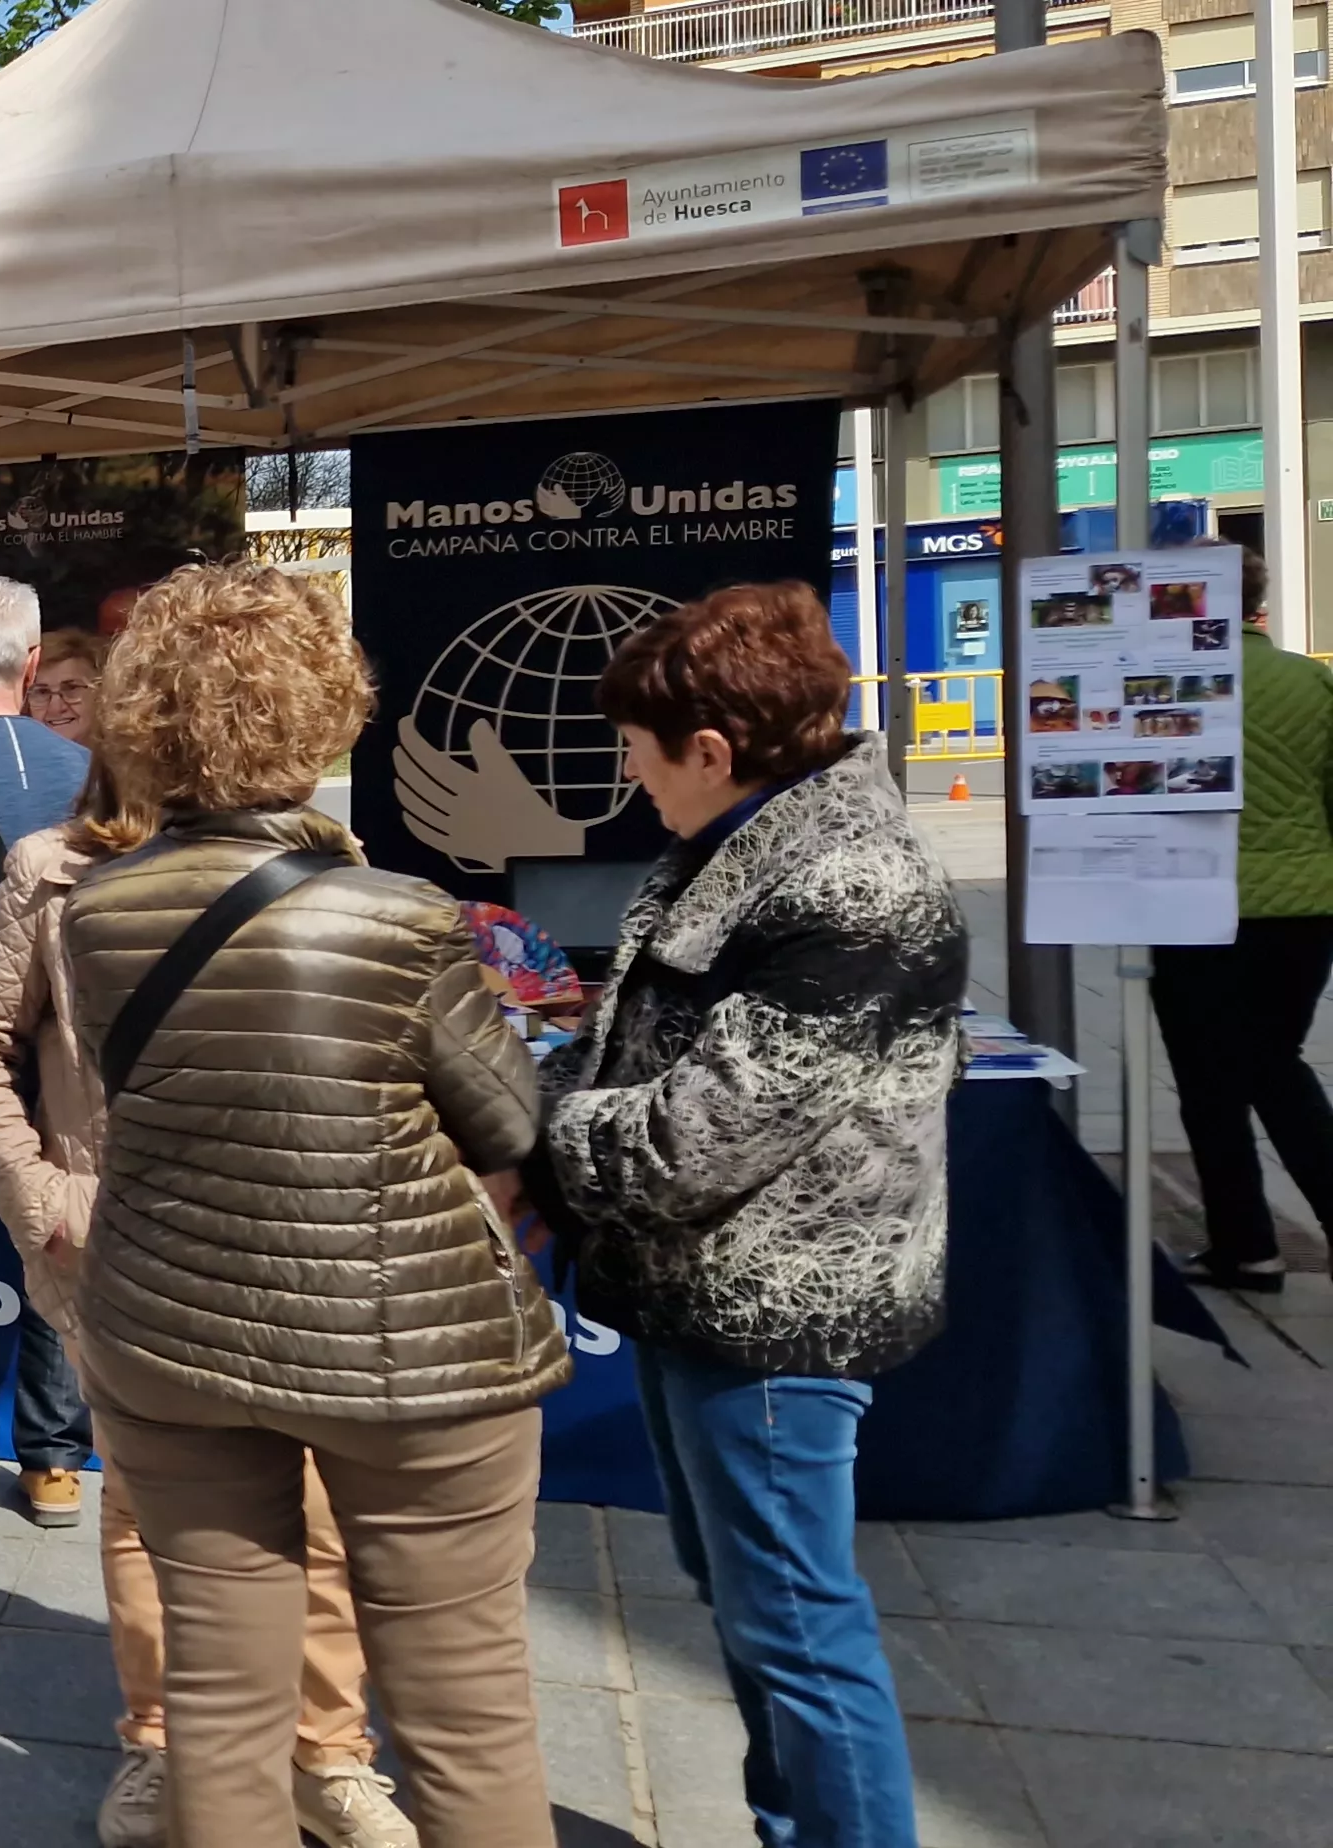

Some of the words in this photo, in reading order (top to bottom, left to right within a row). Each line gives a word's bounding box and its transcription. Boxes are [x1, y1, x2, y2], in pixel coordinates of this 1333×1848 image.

[641, 172, 786, 208] Ayuntamiento
[643, 209, 668, 226] de
[673, 198, 752, 222] Huesca
[49, 509, 125, 527] Unidas
[385, 496, 534, 530] Manos
[630, 480, 799, 516] Unidas
[58, 526, 71, 542] EL
[73, 526, 124, 541] HAMBRE
[388, 528, 520, 559] CAMPAÑA
[527, 524, 640, 551] CONTRA
[649, 525, 675, 545] EL
[683, 518, 795, 543] HAMBRE
[921, 532, 984, 554] MGS
